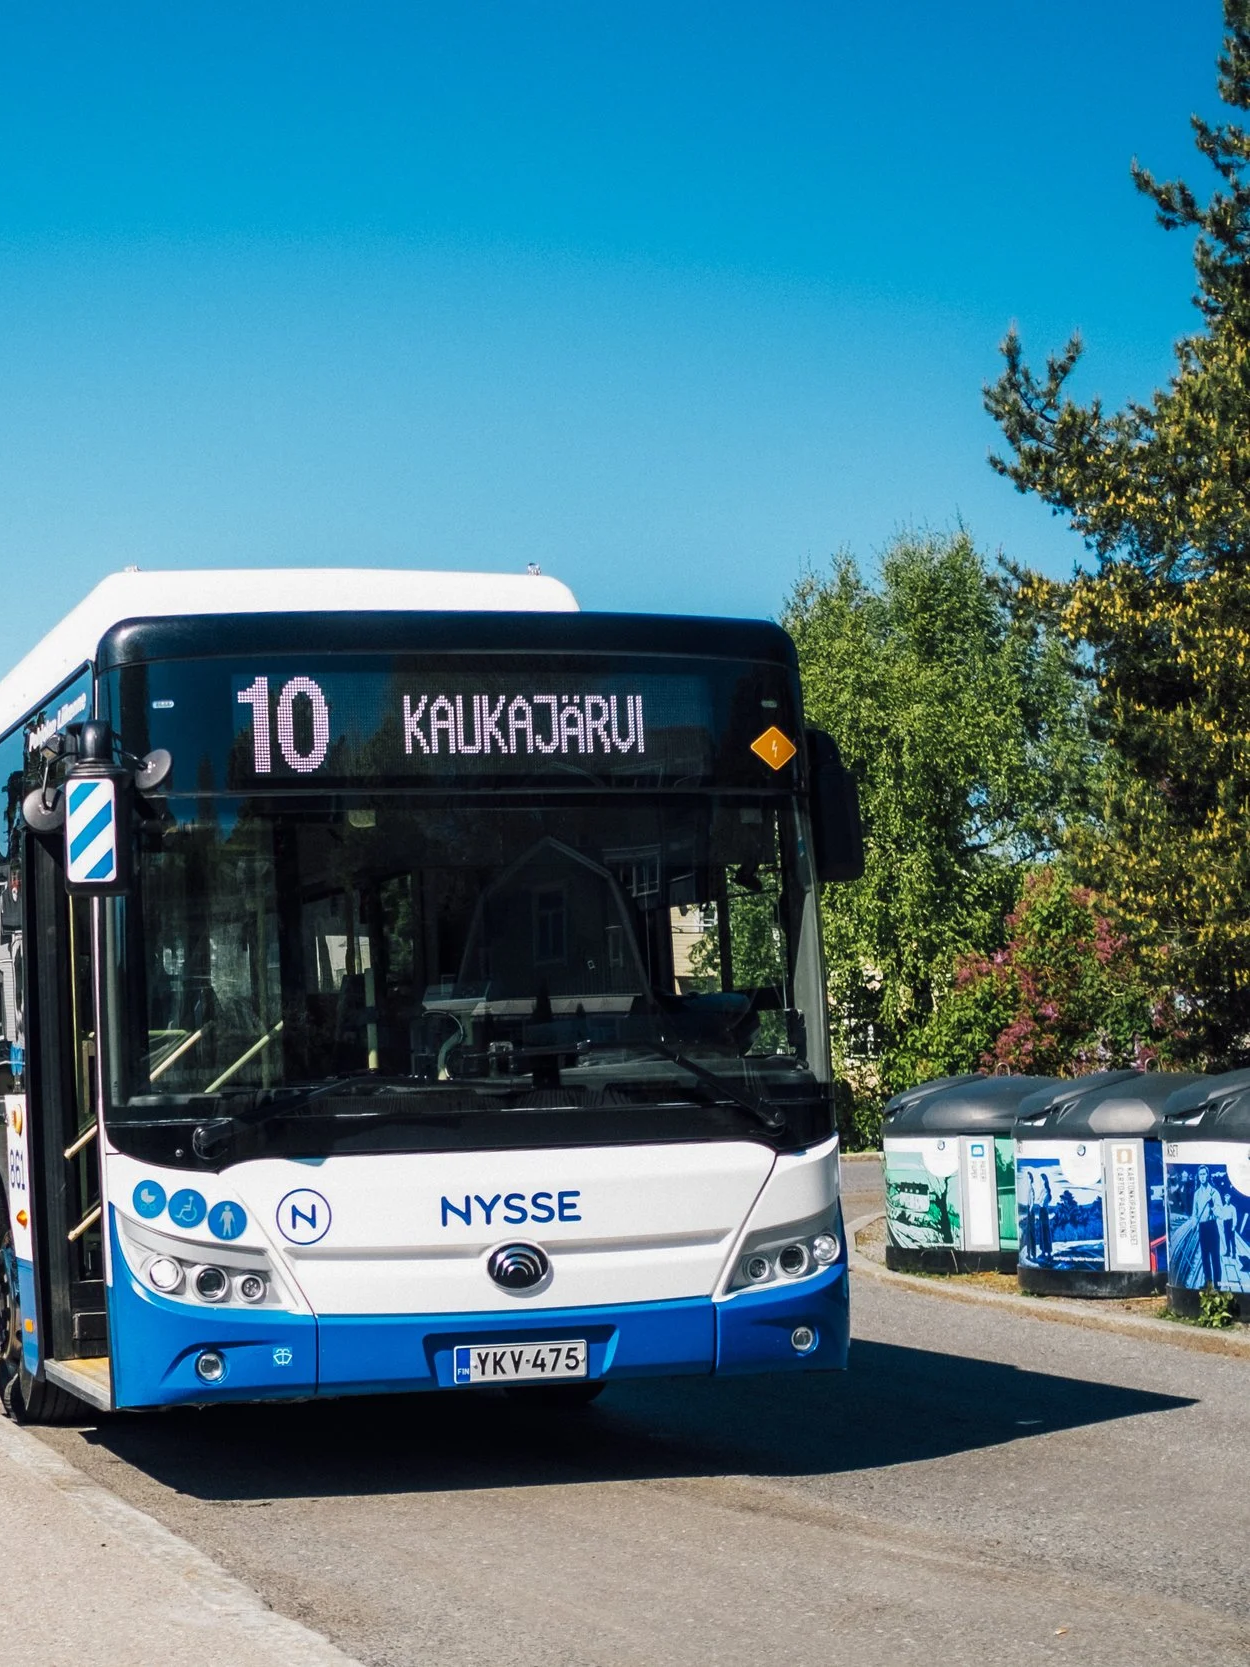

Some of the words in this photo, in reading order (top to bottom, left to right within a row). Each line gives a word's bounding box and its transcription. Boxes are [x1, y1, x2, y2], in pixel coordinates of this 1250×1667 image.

[237, 676, 330, 773] 10
[403, 694, 646, 755] KAUKAJÄRVI
[10, 1148, 26, 1191] 861
[291, 1203, 317, 1230] N
[441, 1190, 582, 1227] NYSSE
[457, 1367, 470, 1376] FIN
[477, 1347, 580, 1376] YKV-475
